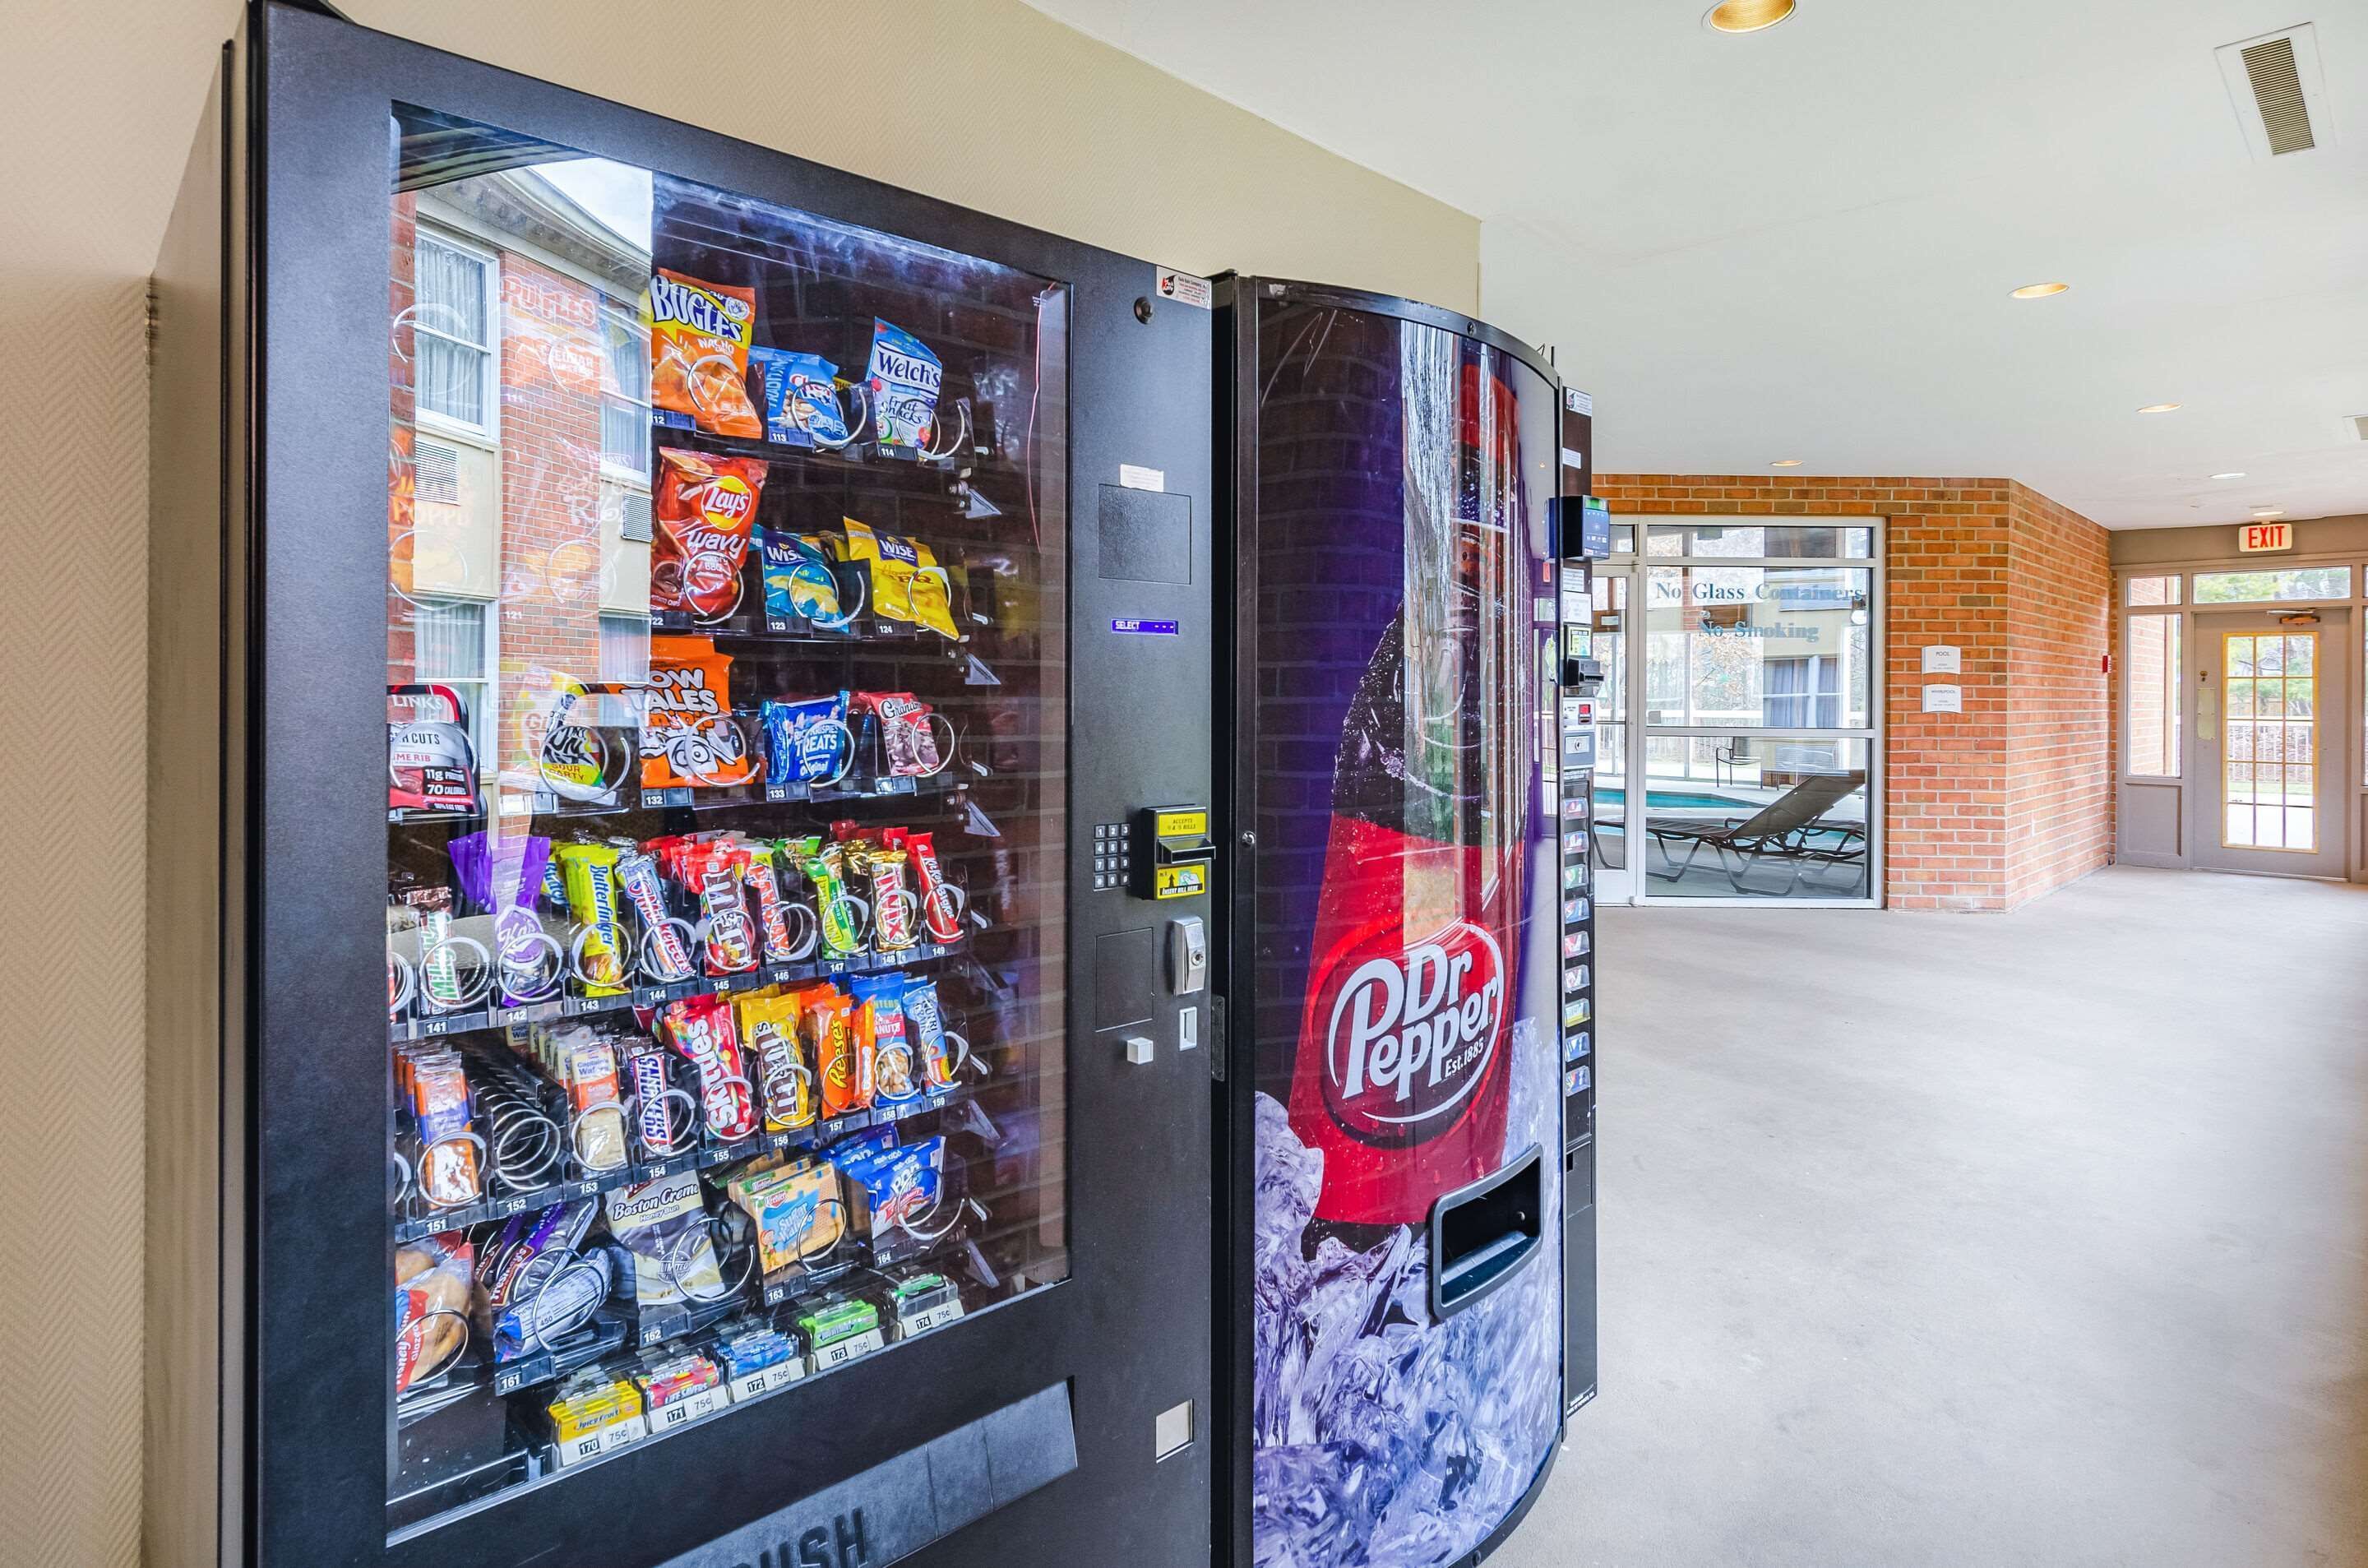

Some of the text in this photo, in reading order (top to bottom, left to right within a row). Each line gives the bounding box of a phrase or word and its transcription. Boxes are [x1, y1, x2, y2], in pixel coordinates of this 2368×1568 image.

[649, 275, 742, 342] BUGLES
[877, 350, 941, 388] Welch's
[653, 414, 665, 424] 12
[772, 432, 787, 442] 113
[881, 447, 895, 456] 114
[705, 486, 749, 518] Lay's
[2248, 525, 2285, 549] EXIT
[879, 539, 916, 559] WISE
[1656, 582, 1864, 602] No Glass Containers
[652, 617, 664, 626] 22
[770, 622, 785, 631] 123
[1115, 621, 1140, 631] SELECT
[879, 625, 893, 633] 124
[1698, 620, 1820, 643] No Smoking
[630, 688, 719, 714] TALES
[411, 733, 441, 745] CUTS
[794, 733, 838, 757] TREATS
[427, 784, 444, 795] 70
[770, 789, 785, 798] 133
[645, 795, 663, 805] 132
[590, 863, 613, 947] Butterfinger
[873, 872, 904, 941] TWIX
[932, 946, 945, 955] 149
[830, 963, 844, 972] 147
[774, 972, 789, 981] 146
[714, 980, 729, 990] 145
[1403, 943, 1473, 1026] Dr
[649, 991, 667, 1001] 144
[580, 1001, 599, 1011] 143
[506, 1011, 526, 1021] 142
[427, 1023, 446, 1034] 141
[875, 1022, 901, 1034] ANUTS
[1328, 958, 1499, 1103] Pepper
[828, 1020, 849, 1089] Reese's
[687, 1018, 738, 1129] Skittles
[932, 1098, 945, 1107] 159
[882, 1110, 895, 1119] 158
[829, 1122, 843, 1131] 157
[773, 1137, 789, 1146] 156
[713, 1152, 729, 1162] 155
[649, 1167, 666, 1177] 154
[580, 1182, 599, 1192] 153
[506, 1200, 526, 1212] 152
[613, 1196, 659, 1221] Boston
[639, 1204, 680, 1223] Honey Bun
[427, 1221, 446, 1232] 151
[877, 1252, 890, 1264] 164
[768, 1289, 784, 1300] 163
[916, 1311, 950, 1329] 174 75¢
[644, 1330, 661, 1343] 162
[831, 1342, 868, 1360] 173 75¢
[501, 1376, 520, 1388] 161
[747, 1370, 788, 1393] 172 75¢
[665, 1391, 687, 1403] LIFE
[668, 1398, 711, 1420] 171 75¢
[580, 1429, 627, 1454] 170 75¢
[732, 1507, 868, 1568] SH
